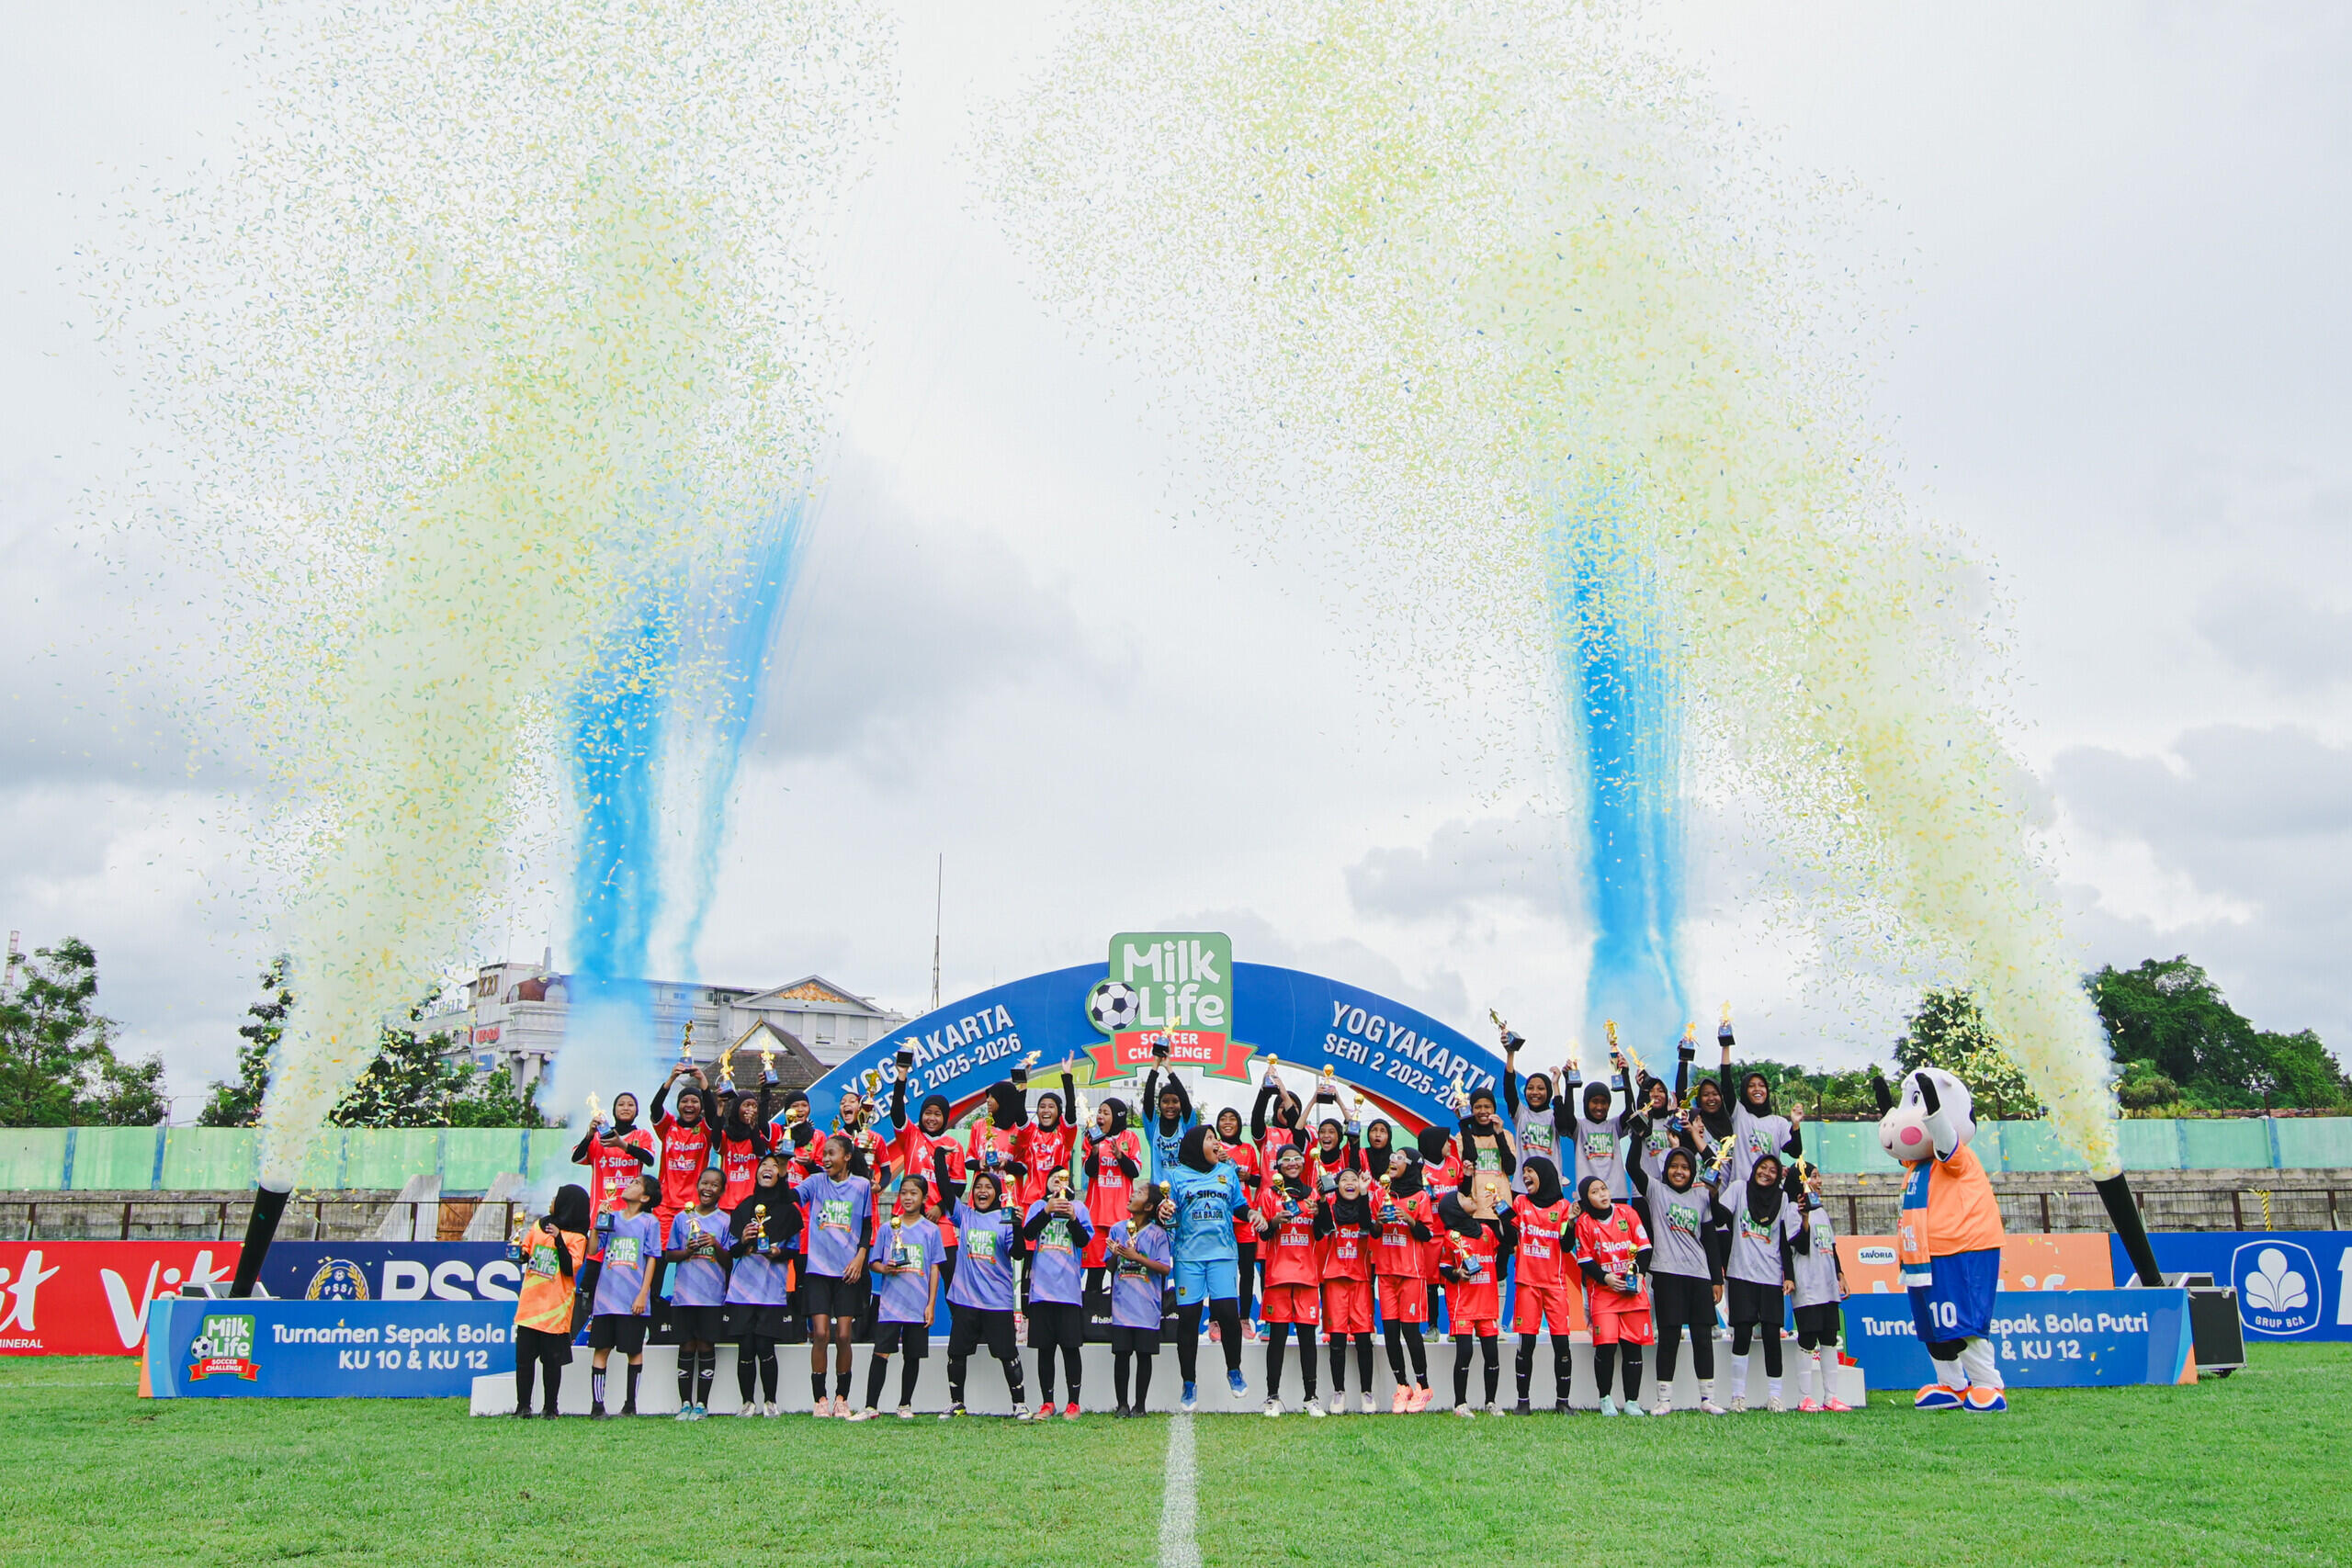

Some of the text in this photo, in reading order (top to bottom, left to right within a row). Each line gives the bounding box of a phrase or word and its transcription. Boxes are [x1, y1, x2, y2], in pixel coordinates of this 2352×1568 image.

[1124, 941, 1221, 984] Milk
[1139, 983, 1225, 1026] Life
[1140, 1032, 1198, 1045] SOCER
[842, 1003, 1015, 1095] YOGAKARTA
[1331, 1000, 1497, 1092] YOGYAKARTA
[1128, 1047, 1212, 1060] CHALENGE
[909, 1078, 924, 1098] 2
[924, 1032, 1022, 1091] 2025-2026
[1323, 1032, 1459, 1111] SERI 2 2025-20
[1527, 1123, 1550, 1137] Milk
[1589, 1134, 1612, 1145] Milk
[826, 1201, 850, 1213] Milk
[1672, 1207, 1695, 1220] Milk
[828, 1213, 851, 1224] Life
[969, 1230, 992, 1243] Milk
[1527, 1226, 1559, 1239] Siloam
[614, 1238, 636, 1250] Milk
[971, 1241, 994, 1255] Life
[615, 1249, 637, 1261] Life
[907, 1246, 920, 1258] ilk
[1860, 1249, 1894, 1259] SAVORIA
[381, 1259, 526, 1301] PSS
[324, 1283, 353, 1296] PSSI
[1309, 1306, 1316, 1319] 2
[1408, 1303, 1416, 1315] 4
[1929, 1301, 1958, 1329] 10
[207, 1315, 250, 1338] Milk
[1991, 1314, 2041, 1339] epak
[2044, 1312, 2094, 1334] Bola
[2097, 1311, 2149, 1333] Putri
[2255, 1315, 2305, 1328] GRUP BCA
[272, 1324, 379, 1344] Turnamen
[384, 1324, 451, 1349] Sepak
[457, 1323, 505, 1344] Bola
[212, 1337, 250, 1358] Life
[2001, 1339, 2082, 1360] & KU 12
[338, 1349, 489, 1370] KU 10 & KU 12
[205, 1364, 243, 1372] CHALLENGE
